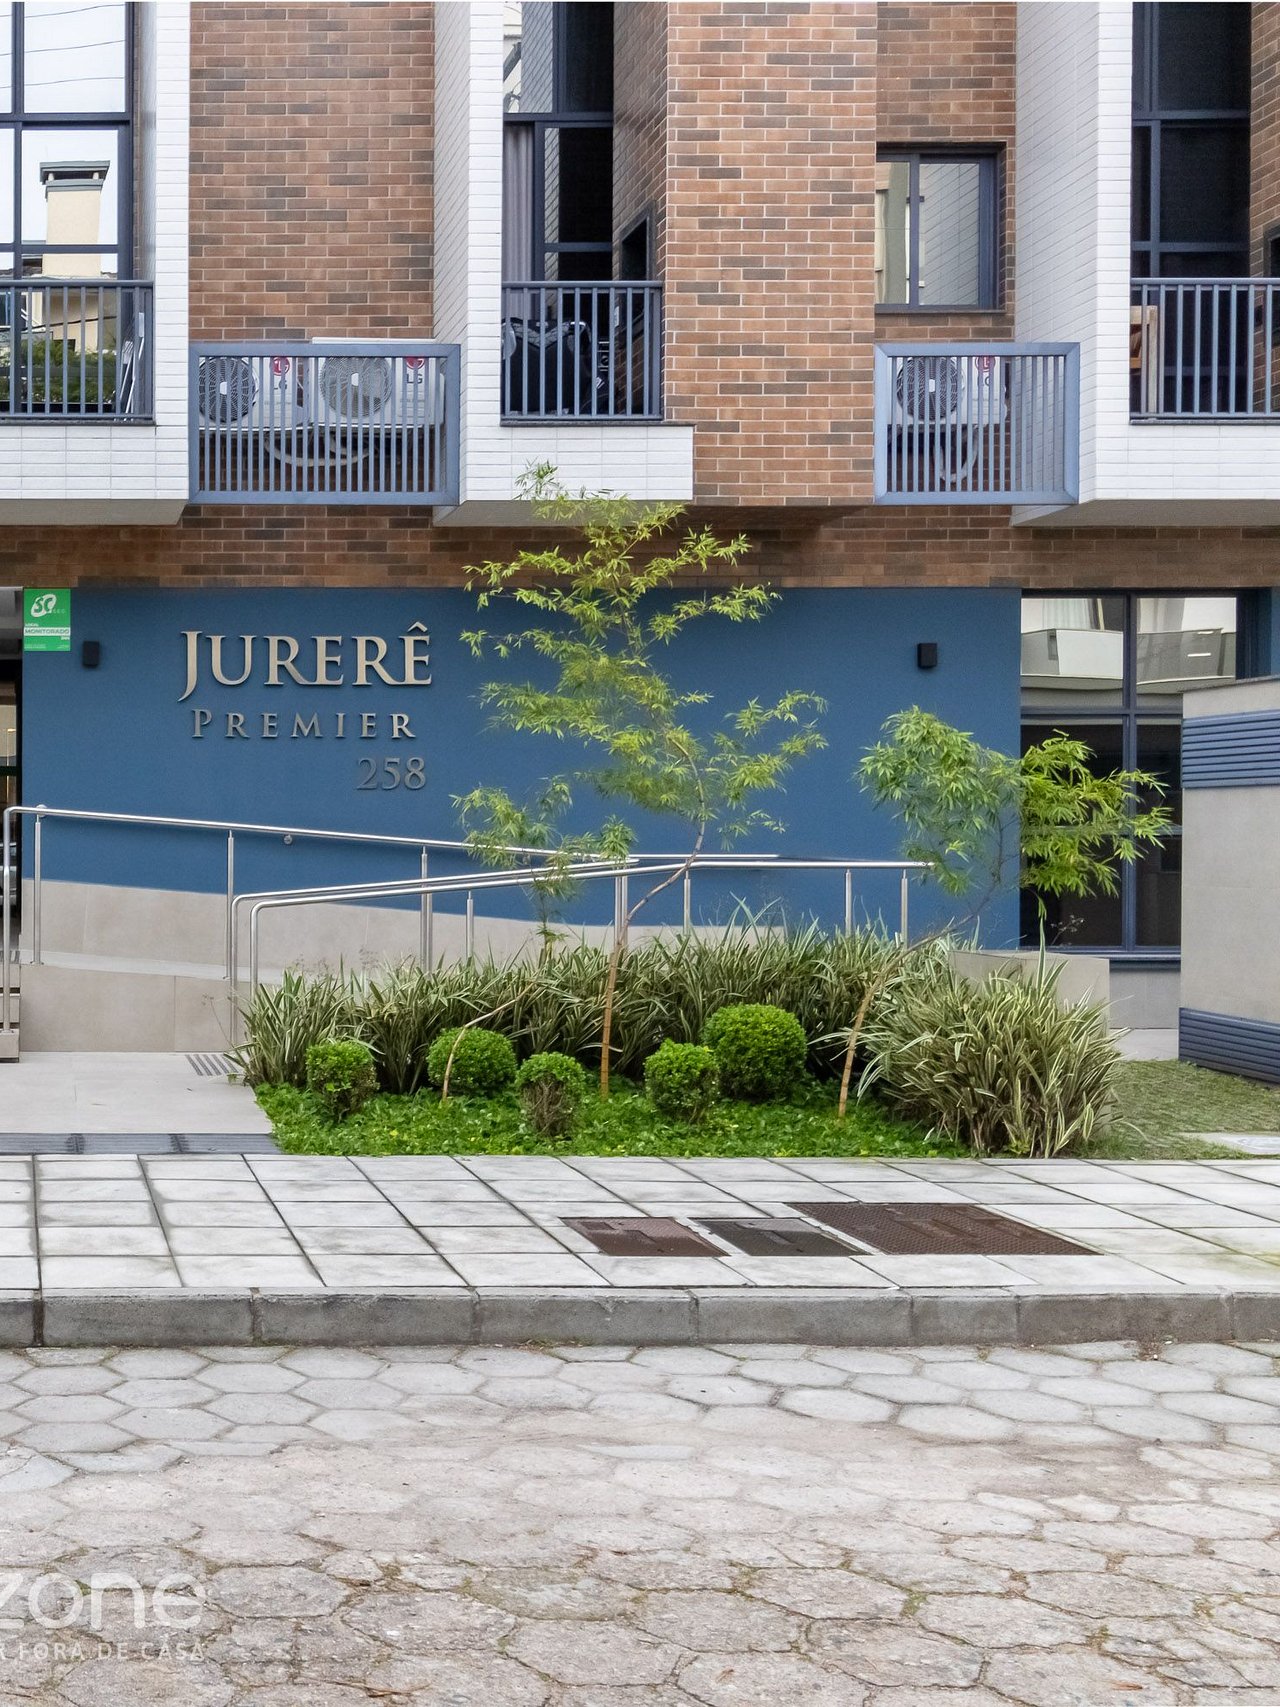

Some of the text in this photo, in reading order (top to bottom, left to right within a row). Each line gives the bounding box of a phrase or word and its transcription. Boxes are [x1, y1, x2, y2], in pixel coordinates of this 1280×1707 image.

[177, 621, 433, 703] JURERÊ
[192, 708, 417, 739] PREMIER
[355, 756, 427, 791] 258
